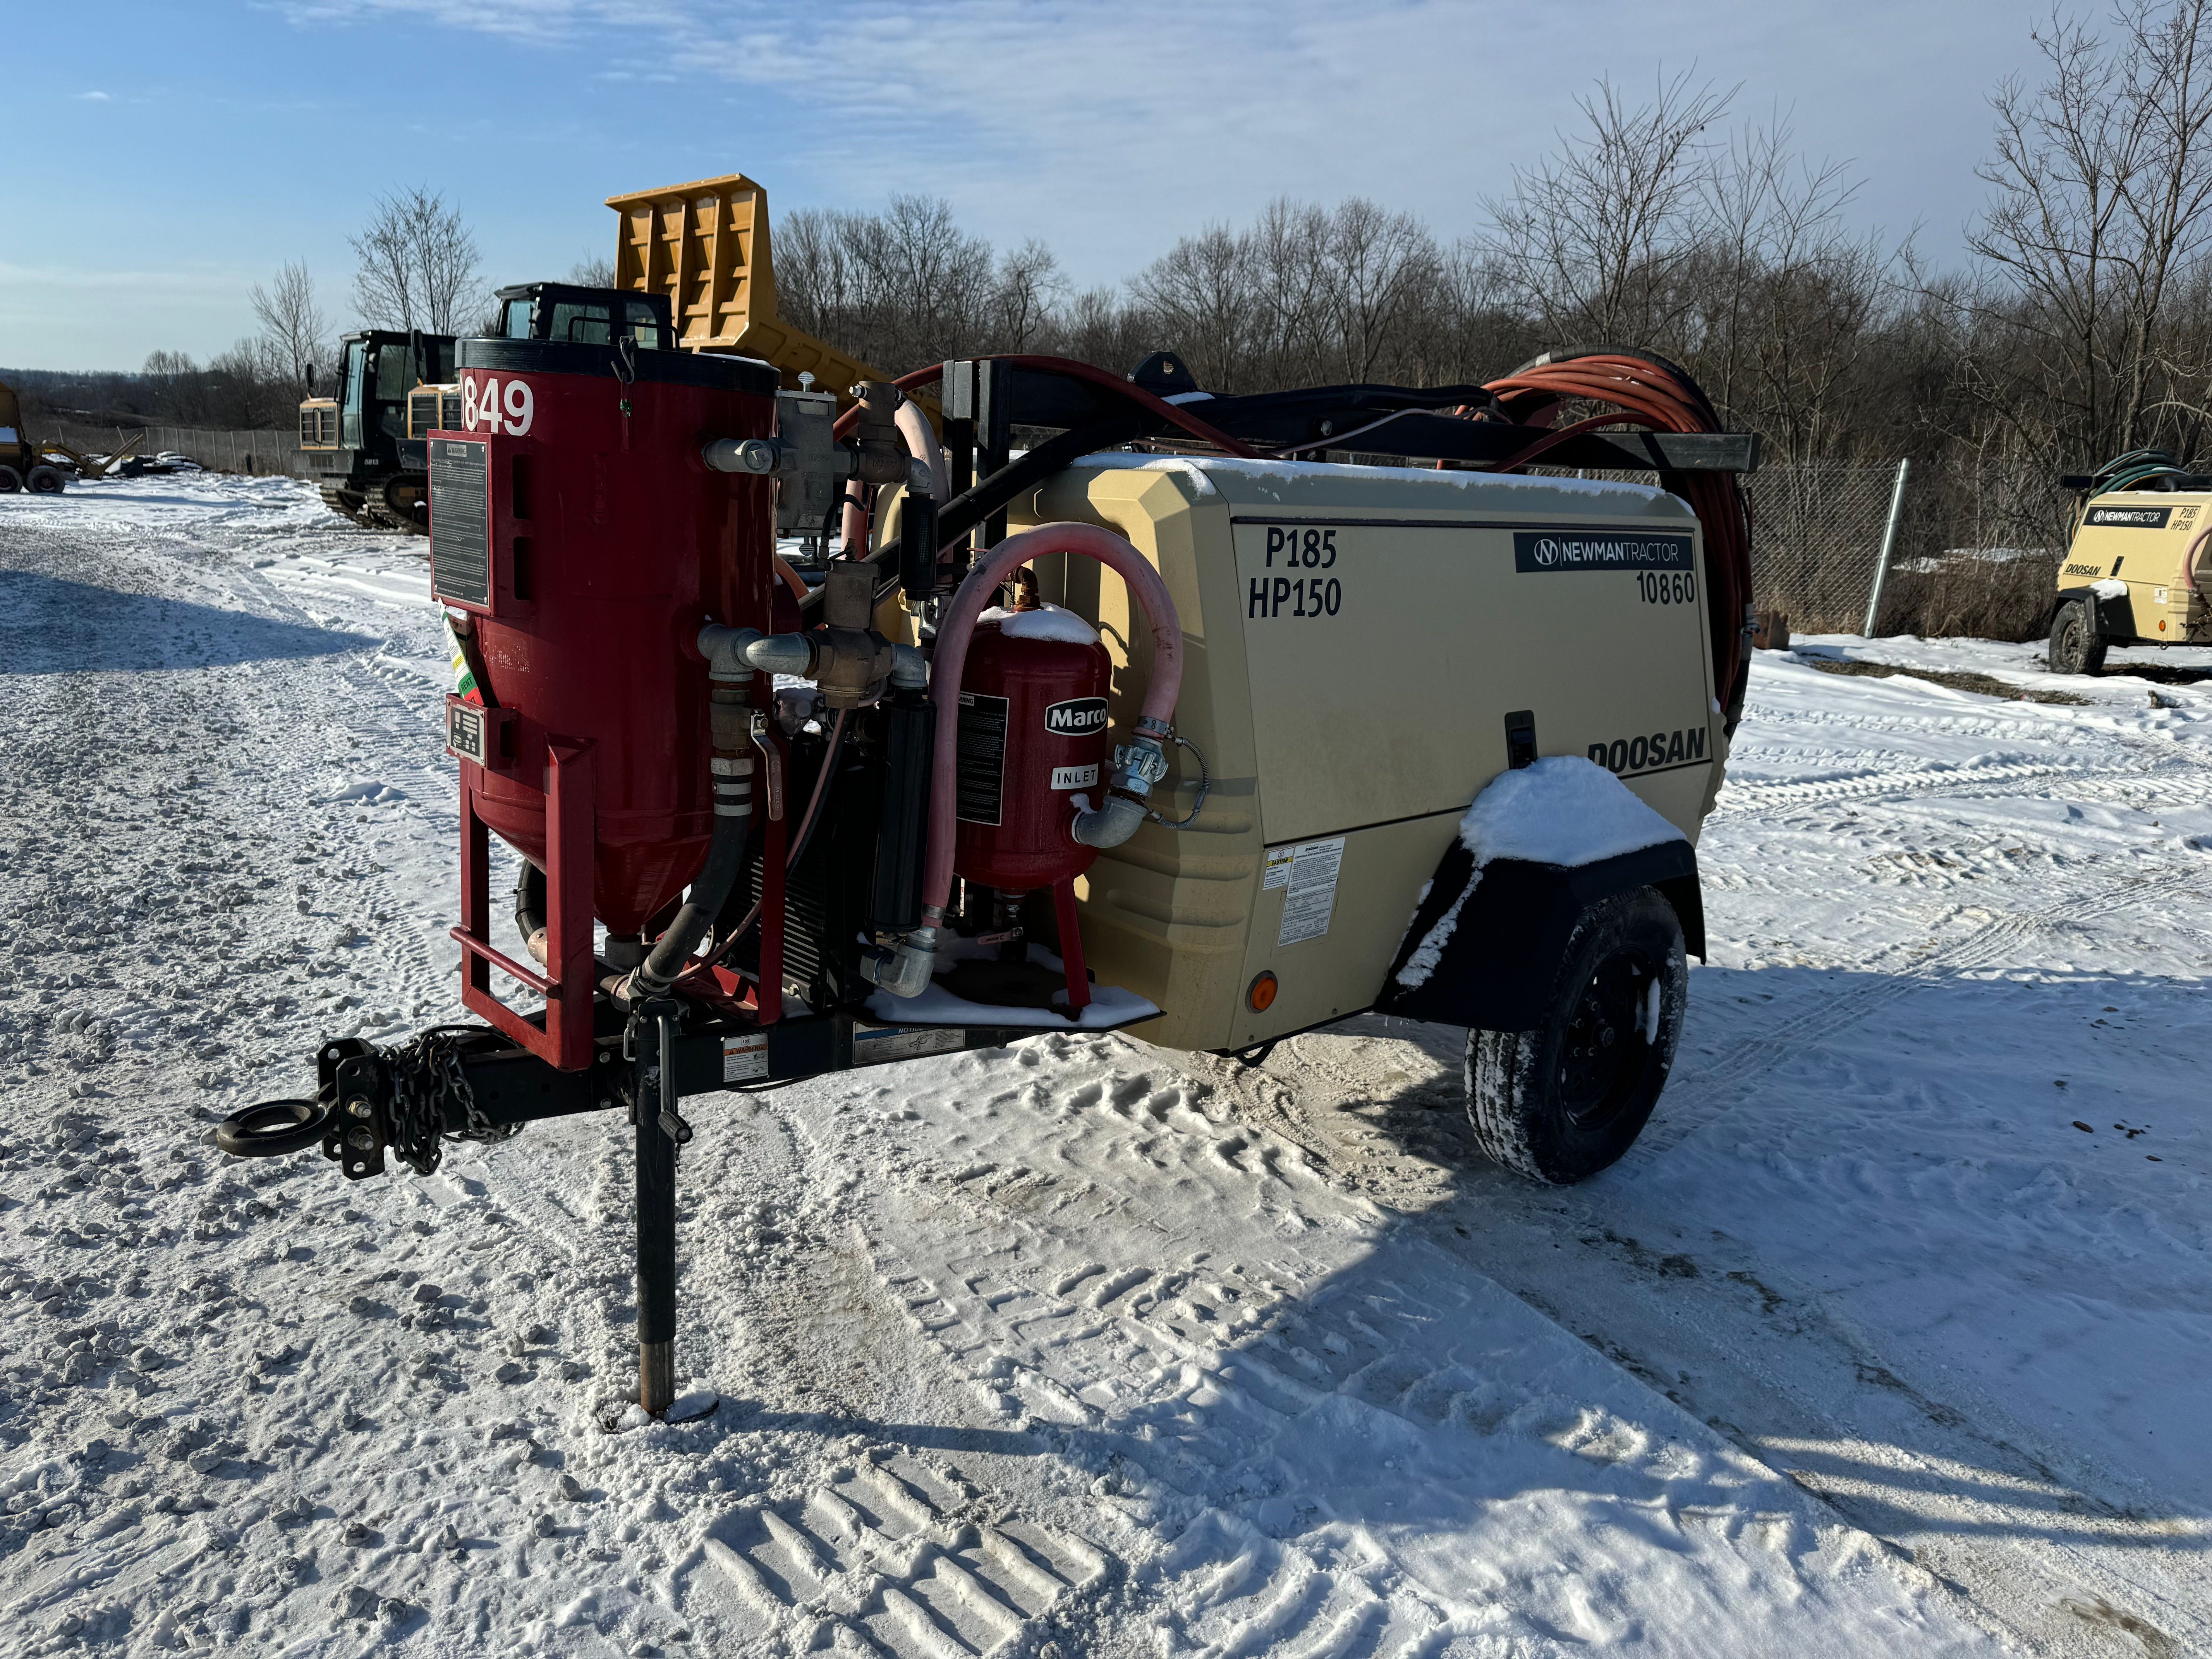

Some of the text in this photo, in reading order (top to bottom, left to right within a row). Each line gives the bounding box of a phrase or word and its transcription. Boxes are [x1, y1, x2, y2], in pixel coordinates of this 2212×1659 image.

[2179, 508, 2198, 519] P185
[2170, 520, 2193, 531] HP150
[1266, 527, 1336, 568] P185
[2065, 563, 2102, 576] DOOSAN
[1637, 570, 1695, 605] 10860
[1249, 577, 1341, 618] HP150
[461, 677, 472, 692] RENT
[1050, 708, 1106, 727] Marco
[1588, 727, 1705, 773] DOOSAN
[1057, 769, 1096, 784] INLET
[736, 1045, 763, 1054] WARNING
